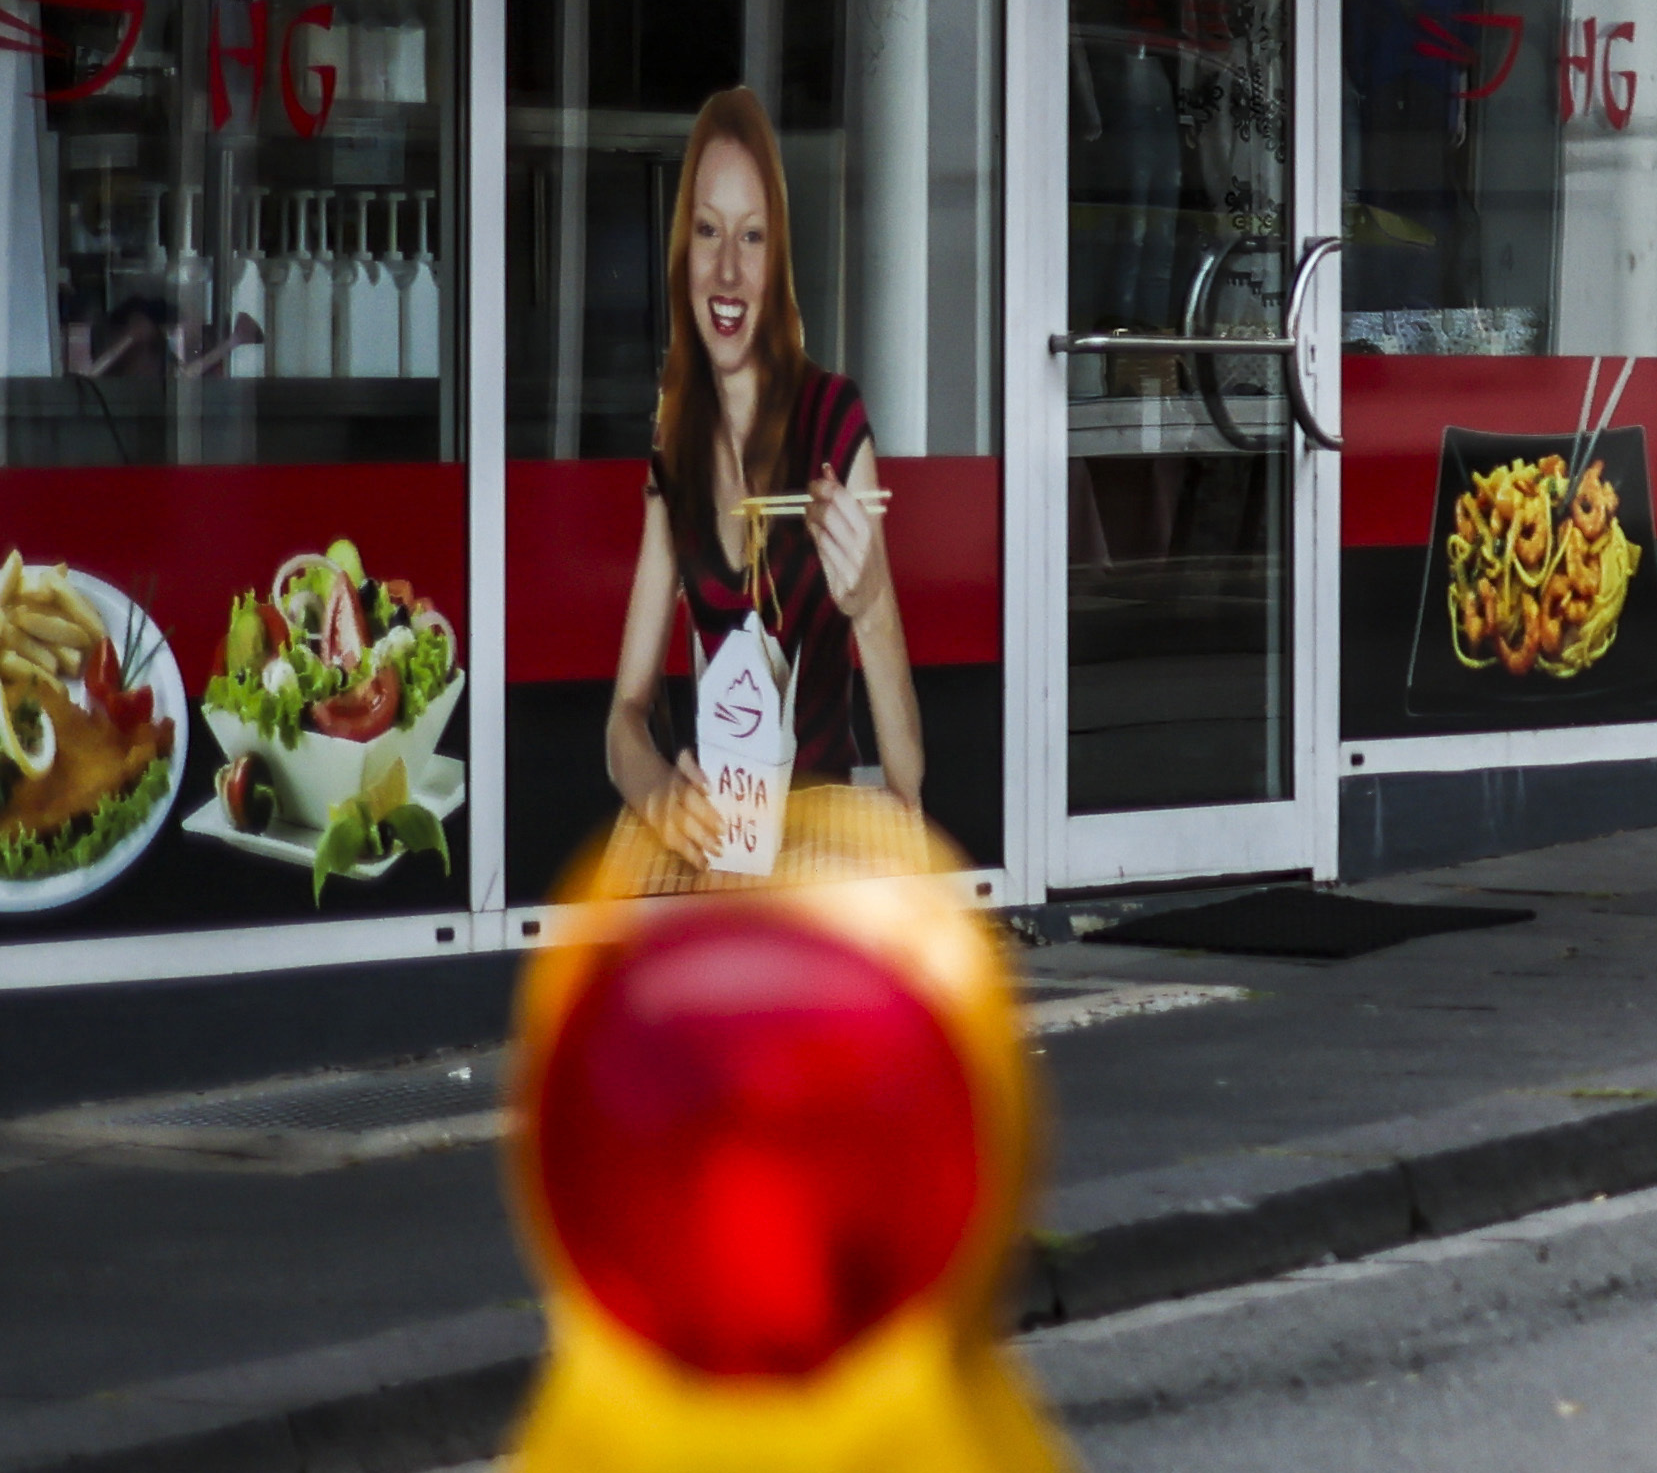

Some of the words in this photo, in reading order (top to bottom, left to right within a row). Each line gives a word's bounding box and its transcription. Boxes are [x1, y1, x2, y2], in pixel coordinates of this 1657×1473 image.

[209, 0, 336, 138] HG
[1558, 17, 1637, 130] HG
[719, 764, 769, 810] ASIA
[727, 814, 758, 853] HG
